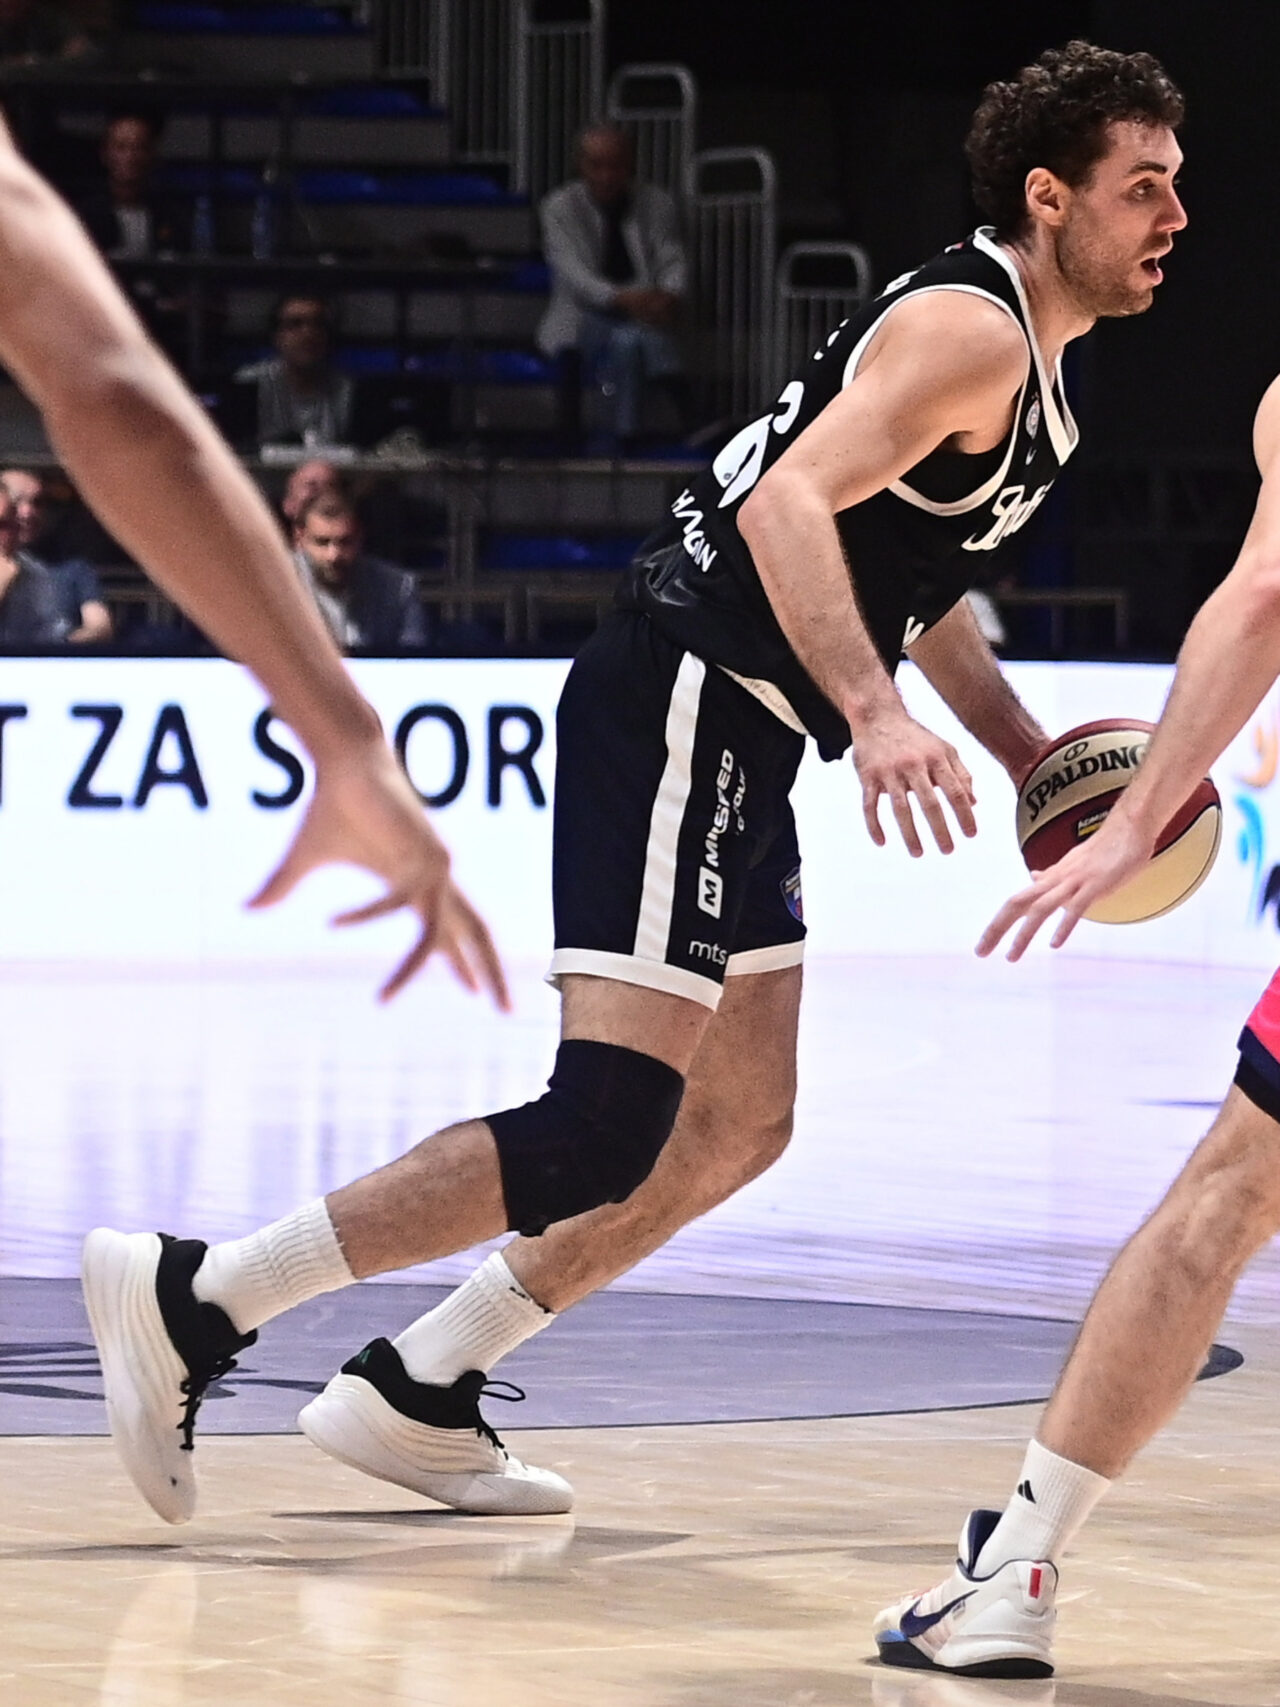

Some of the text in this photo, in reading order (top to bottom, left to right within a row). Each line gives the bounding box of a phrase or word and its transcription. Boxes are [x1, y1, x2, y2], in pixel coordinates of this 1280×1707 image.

[68, 705, 208, 808] ZA
[251, 704, 547, 809] SOR
[689, 940, 728, 966] mts
